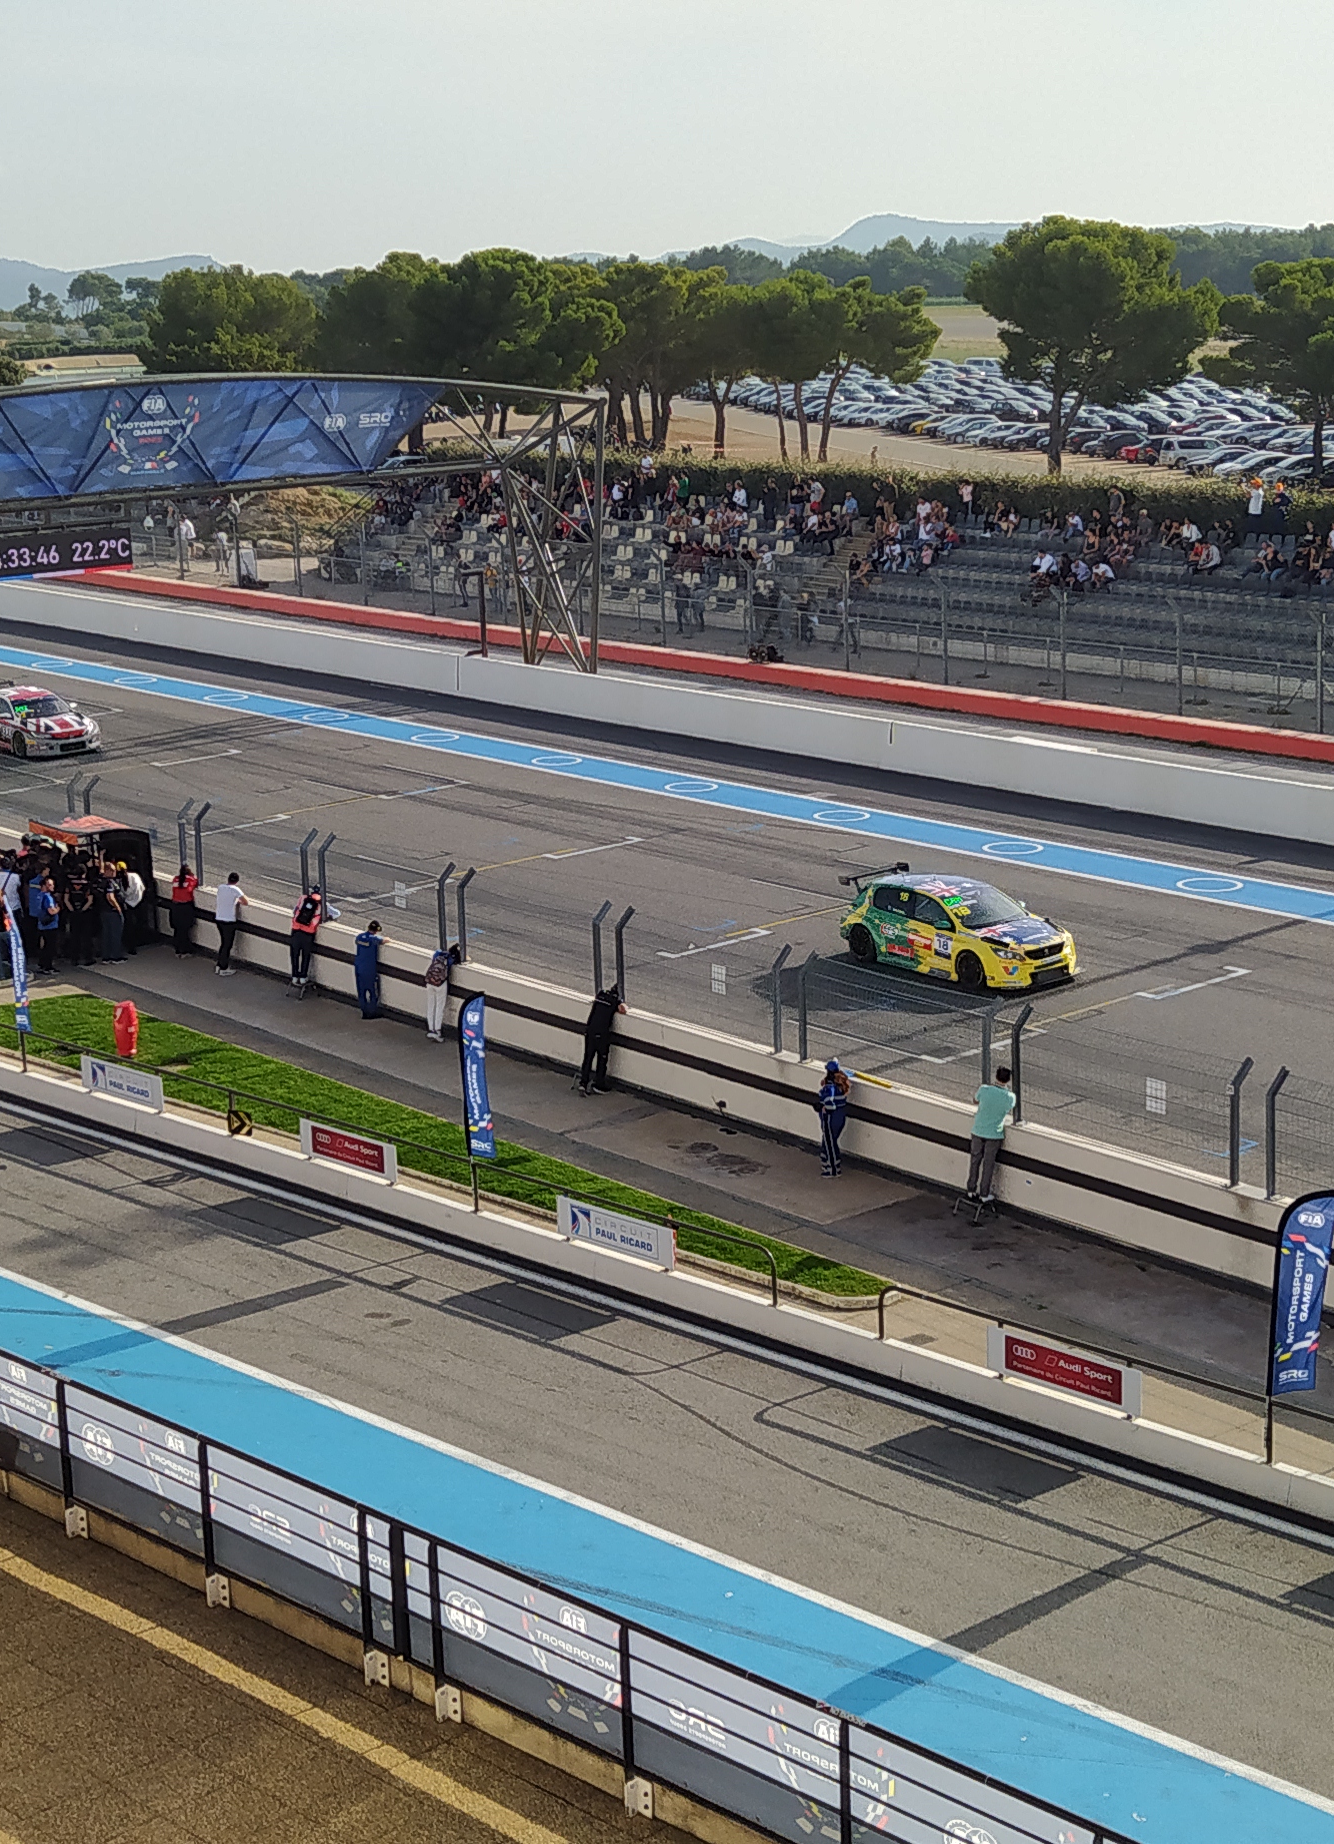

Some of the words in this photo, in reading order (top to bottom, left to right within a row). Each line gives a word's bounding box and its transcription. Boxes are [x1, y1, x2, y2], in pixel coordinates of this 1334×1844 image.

[116, 418, 188, 430] MOTORSPORT
[358, 412, 392, 424] SRO
[952, 906, 971, 916] 18
[936, 938, 949, 951] 18
[344, 1140, 359, 1151] Audi
[359, 1145, 379, 1157] Sport
[1299, 1213, 1324, 1227] FIA
[595, 1216, 652, 1240] CIRCUIT
[595, 1228, 617, 1242] PAUL
[620, 1234, 653, 1252] RICARD
[1286, 1249, 1306, 1344] MOTORSPORT
[1299, 1273, 1314, 1322] GAMES
[1058, 1359, 1082, 1373] Audi
[1084, 1366, 1113, 1384] Sport
[1278, 1369, 1309, 1380] SRO
